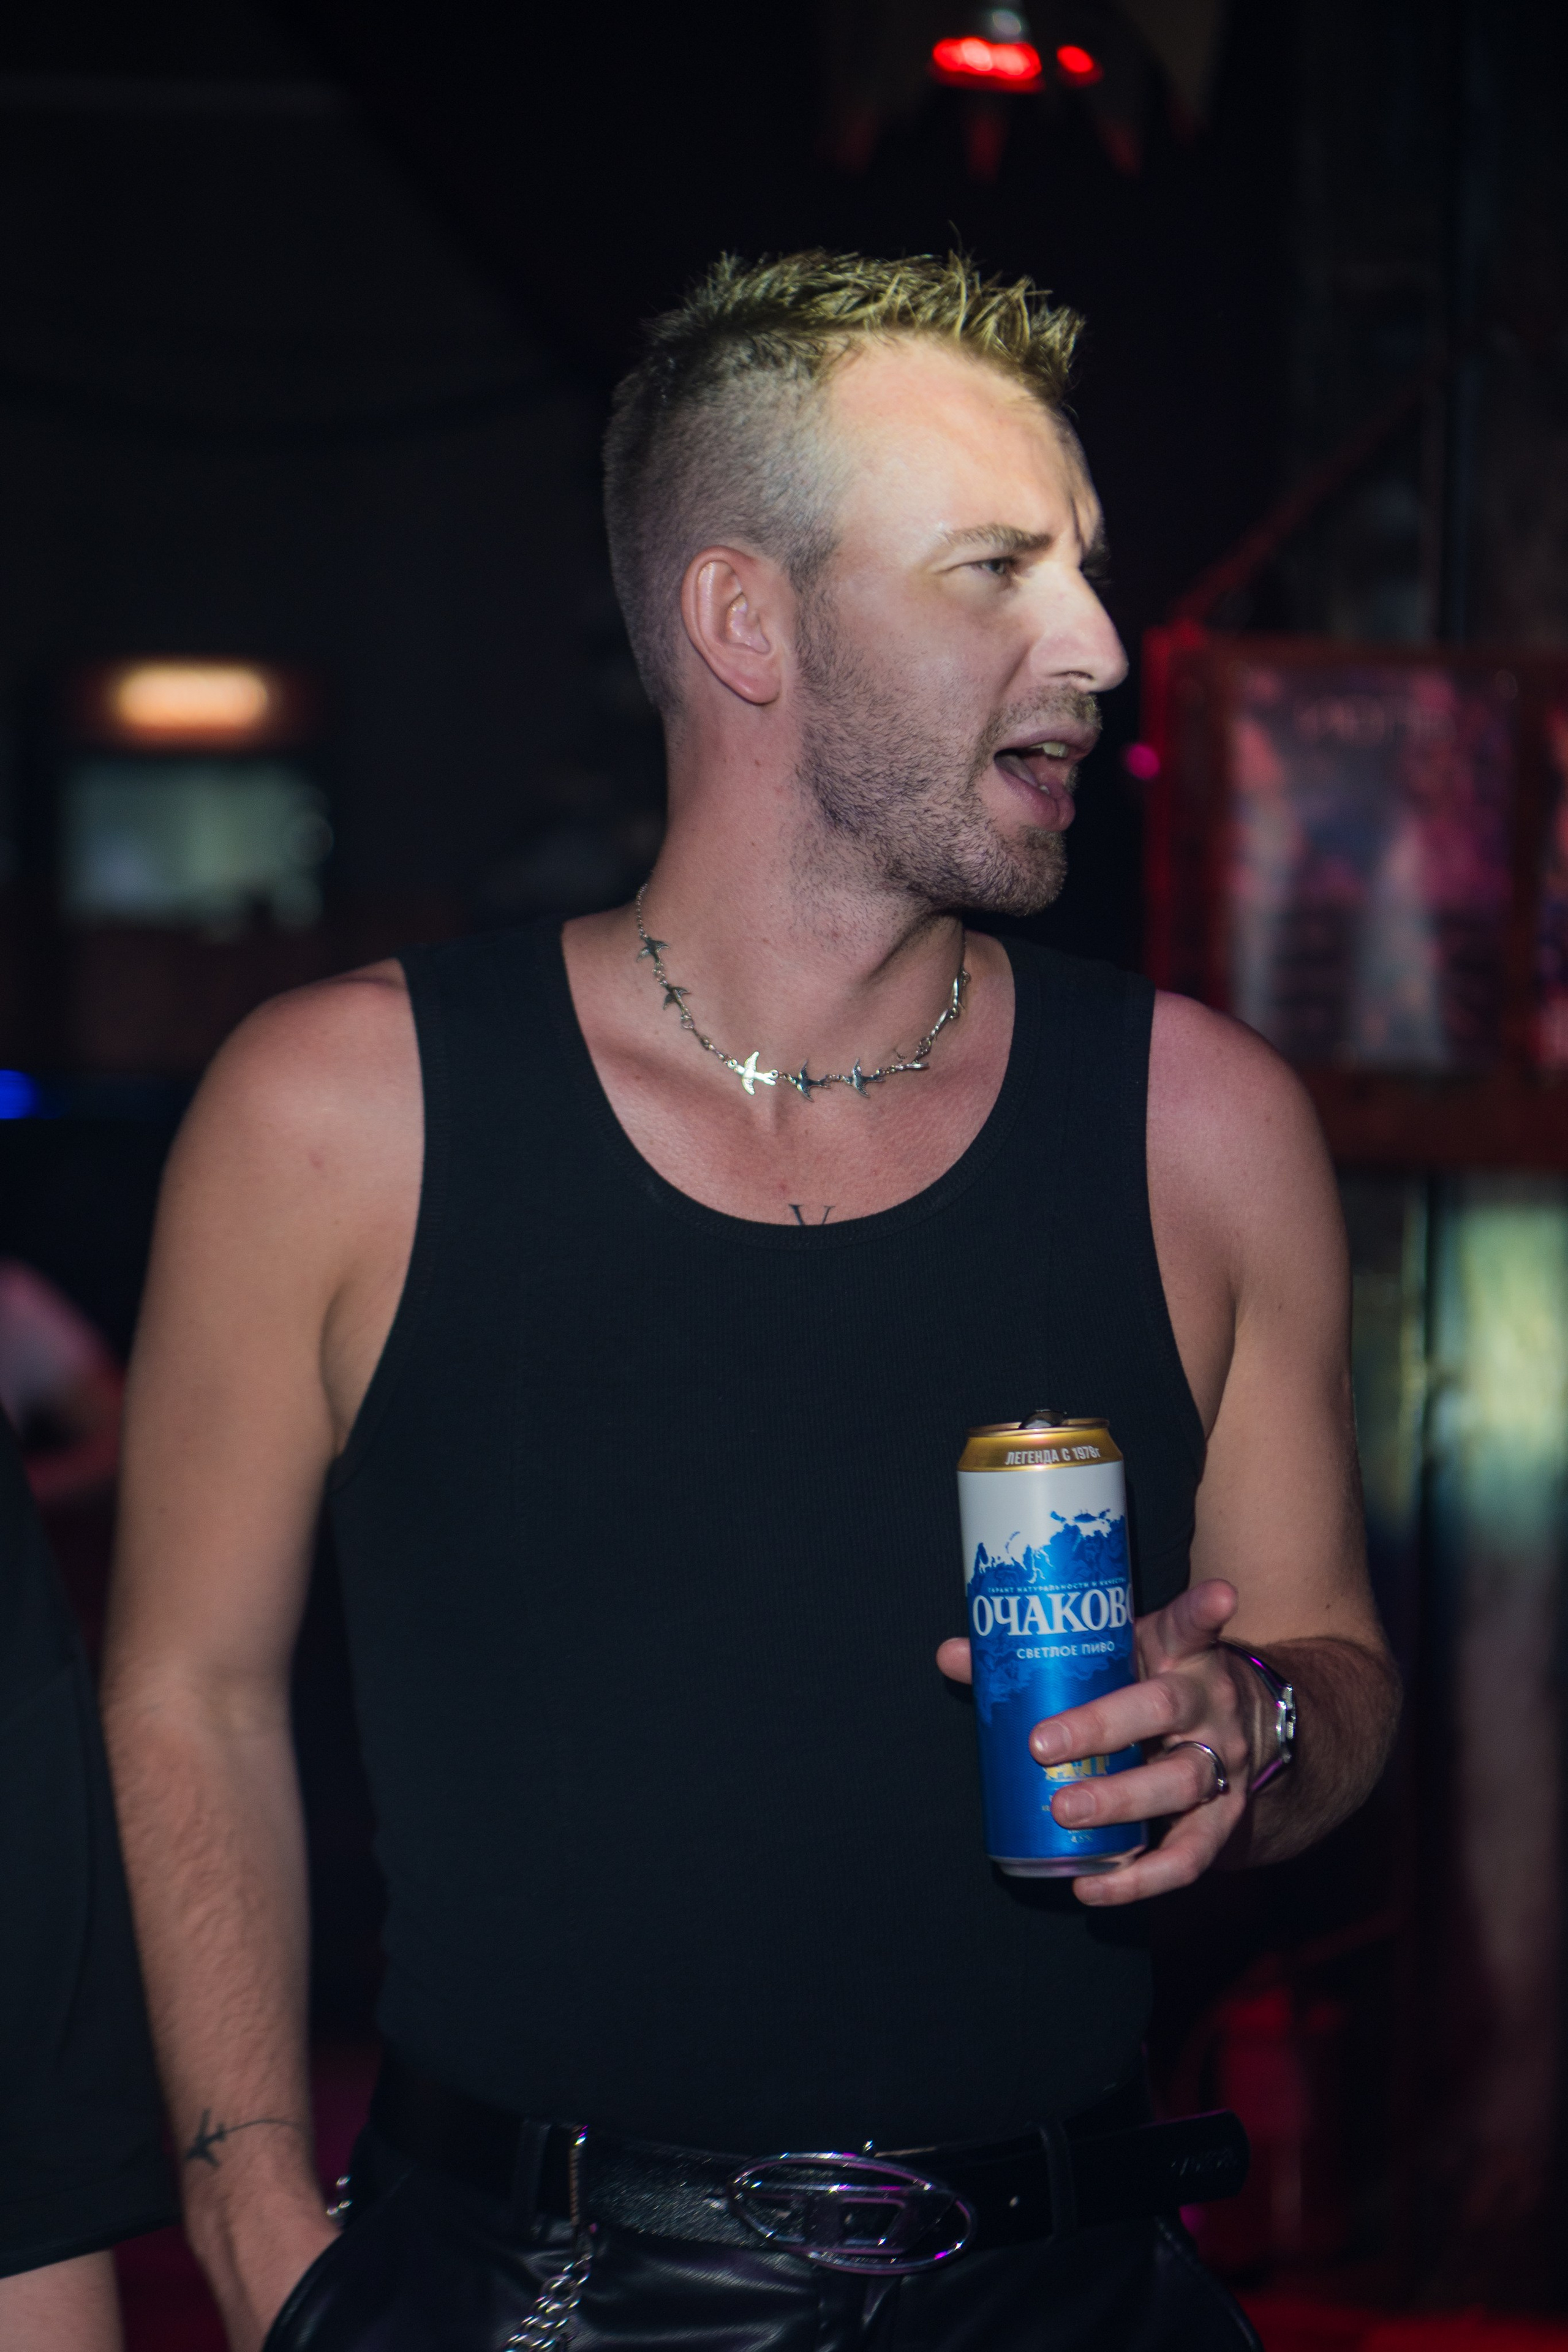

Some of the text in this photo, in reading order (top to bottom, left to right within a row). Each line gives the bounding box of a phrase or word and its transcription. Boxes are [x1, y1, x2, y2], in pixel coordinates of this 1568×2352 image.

[1005, 1449, 1060, 1466] ЛЕГЕНДА
[1061, 1447, 1071, 1461] С
[1016, 1640, 1115, 1659] СВЕТЛОЕ ПИВО
